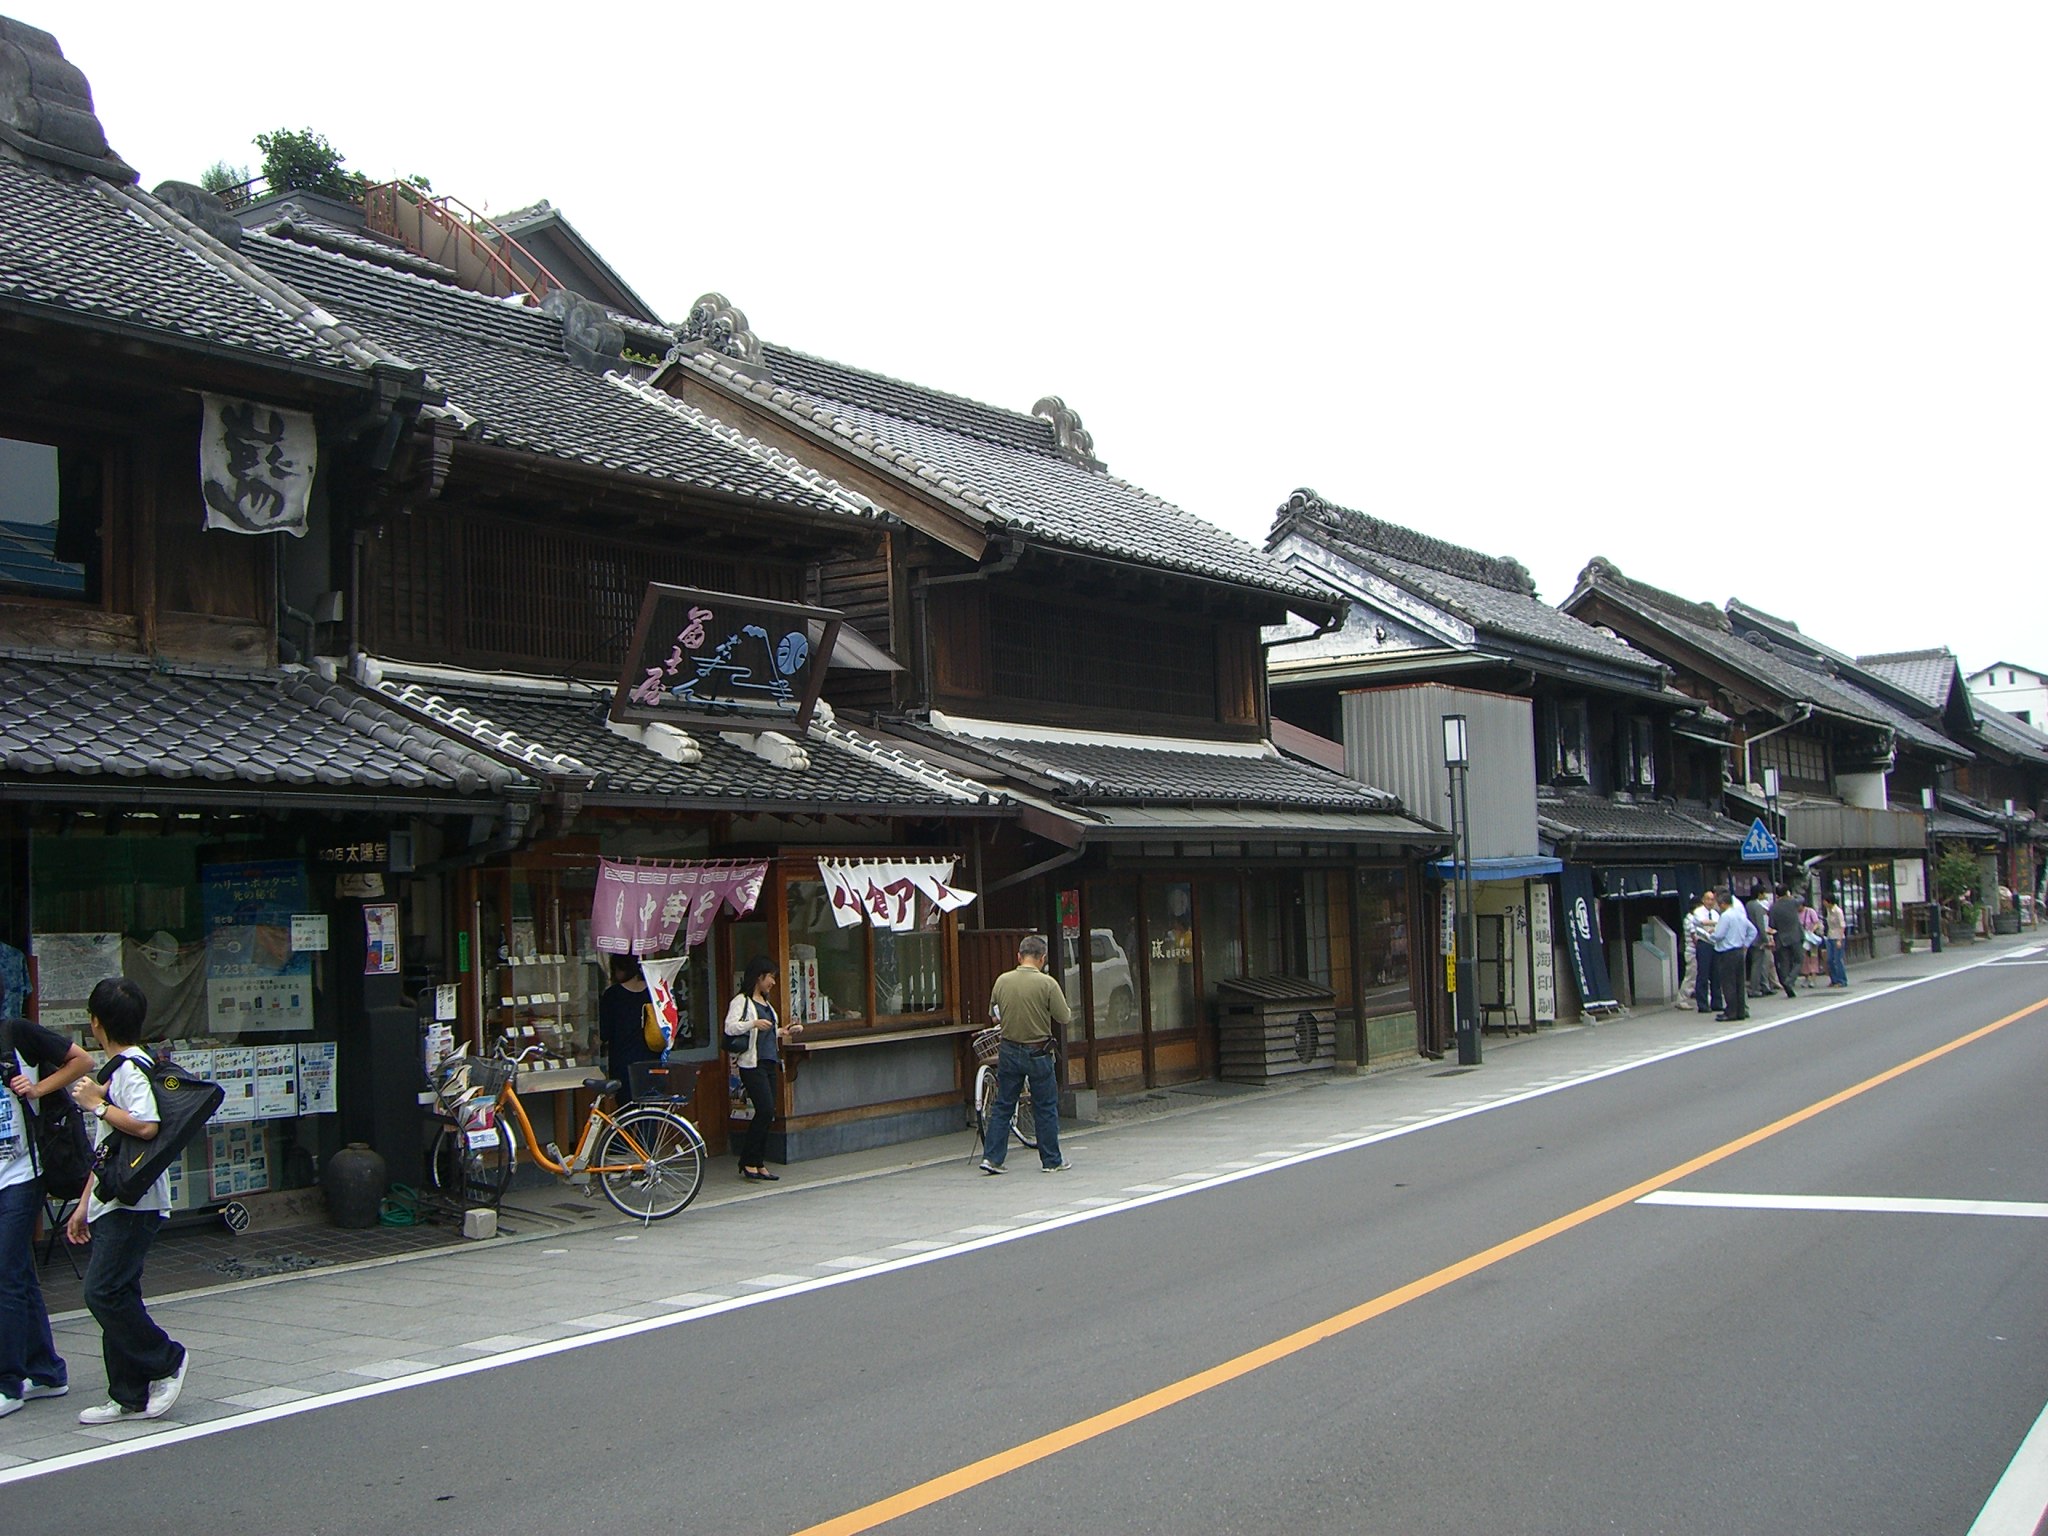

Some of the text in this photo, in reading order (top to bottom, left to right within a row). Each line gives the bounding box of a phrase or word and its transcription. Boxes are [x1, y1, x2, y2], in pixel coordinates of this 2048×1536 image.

[346, 842, 388, 863] 太陽堂
[1535, 927, 1555, 1015] 鳴海印刷
